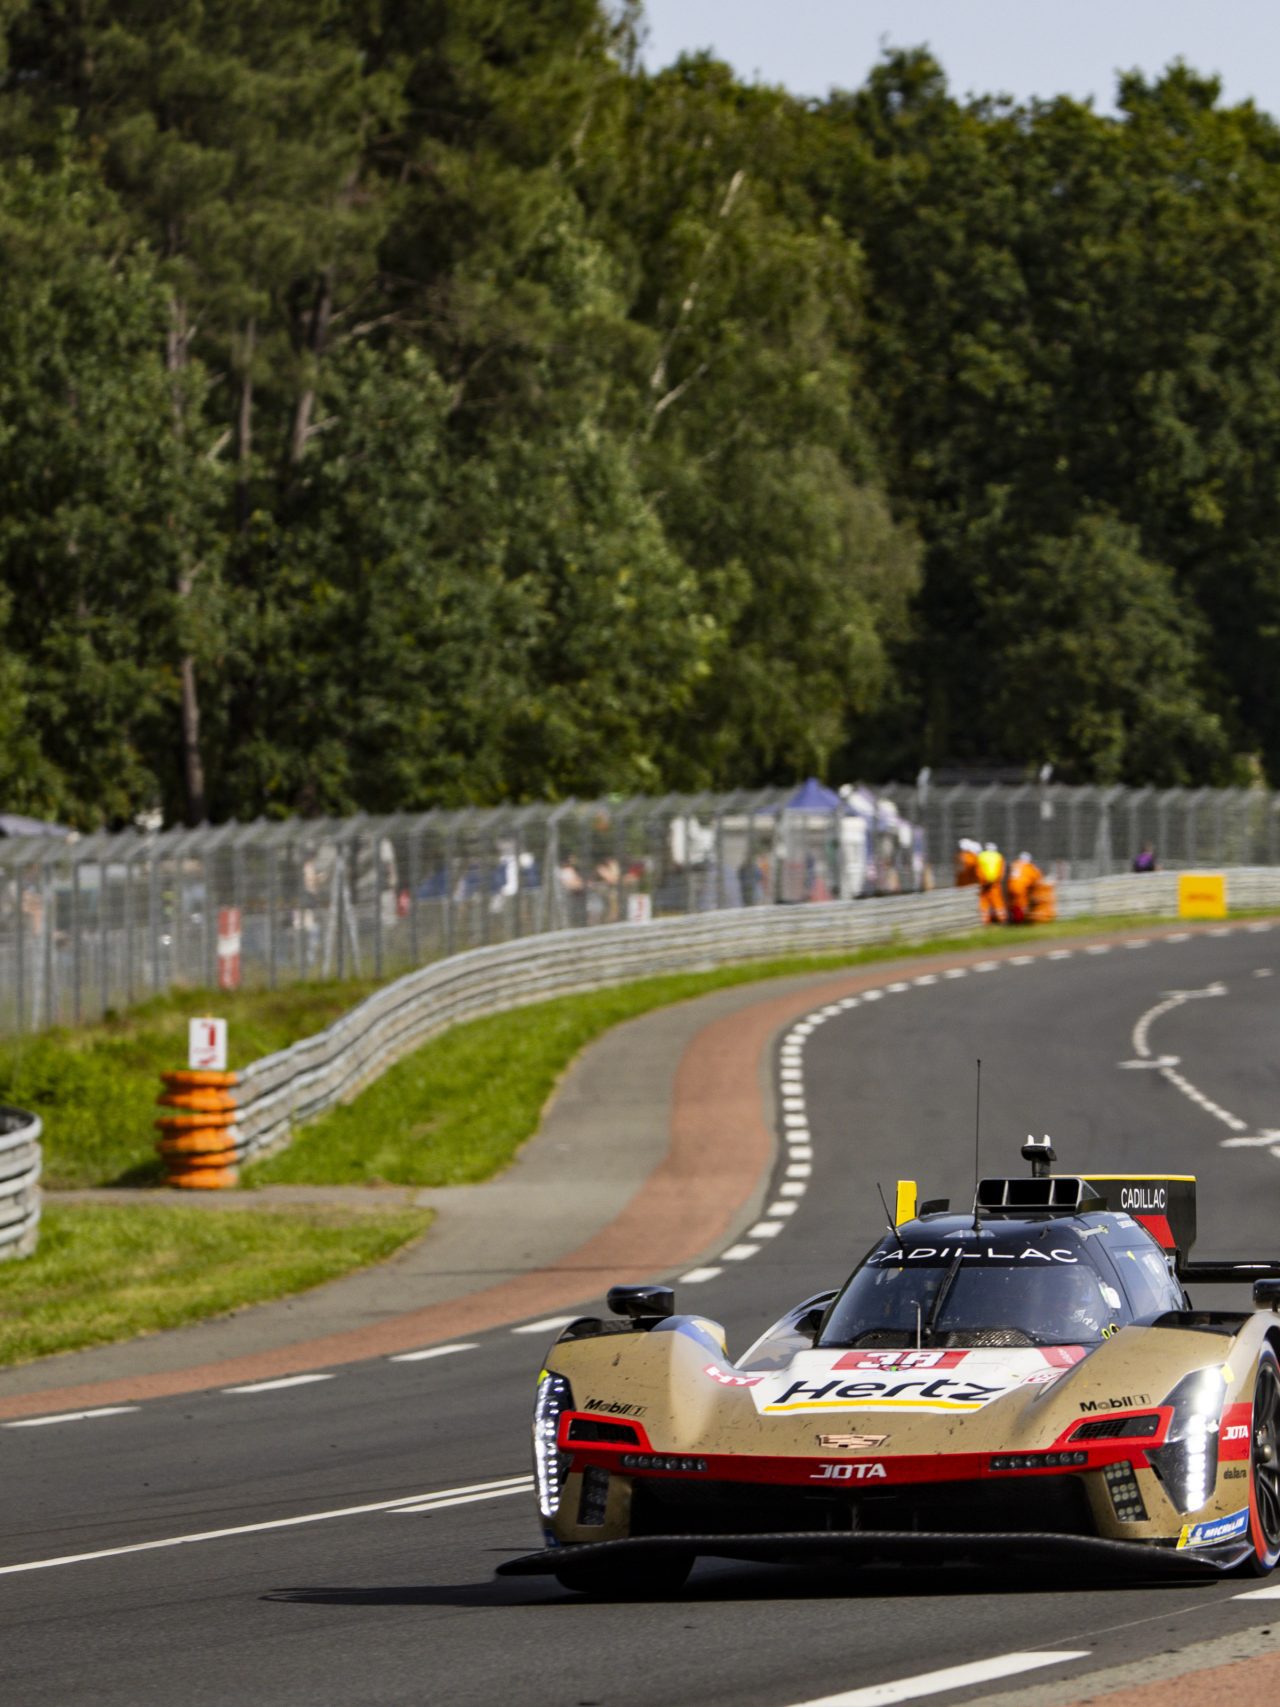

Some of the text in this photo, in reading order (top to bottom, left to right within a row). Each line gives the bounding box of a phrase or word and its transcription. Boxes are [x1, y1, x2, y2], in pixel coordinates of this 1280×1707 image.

[1121, 1188, 1166, 1209] CADILLAC
[867, 1248, 1078, 1264] CADILLAC
[772, 1378, 1006, 1404] Hertz
[584, 1399, 632, 1415] Mobil
[1080, 1396, 1133, 1412] Mobil
[1222, 1425, 1249, 1440] JOTA
[809, 1463, 887, 1479] JOTA
